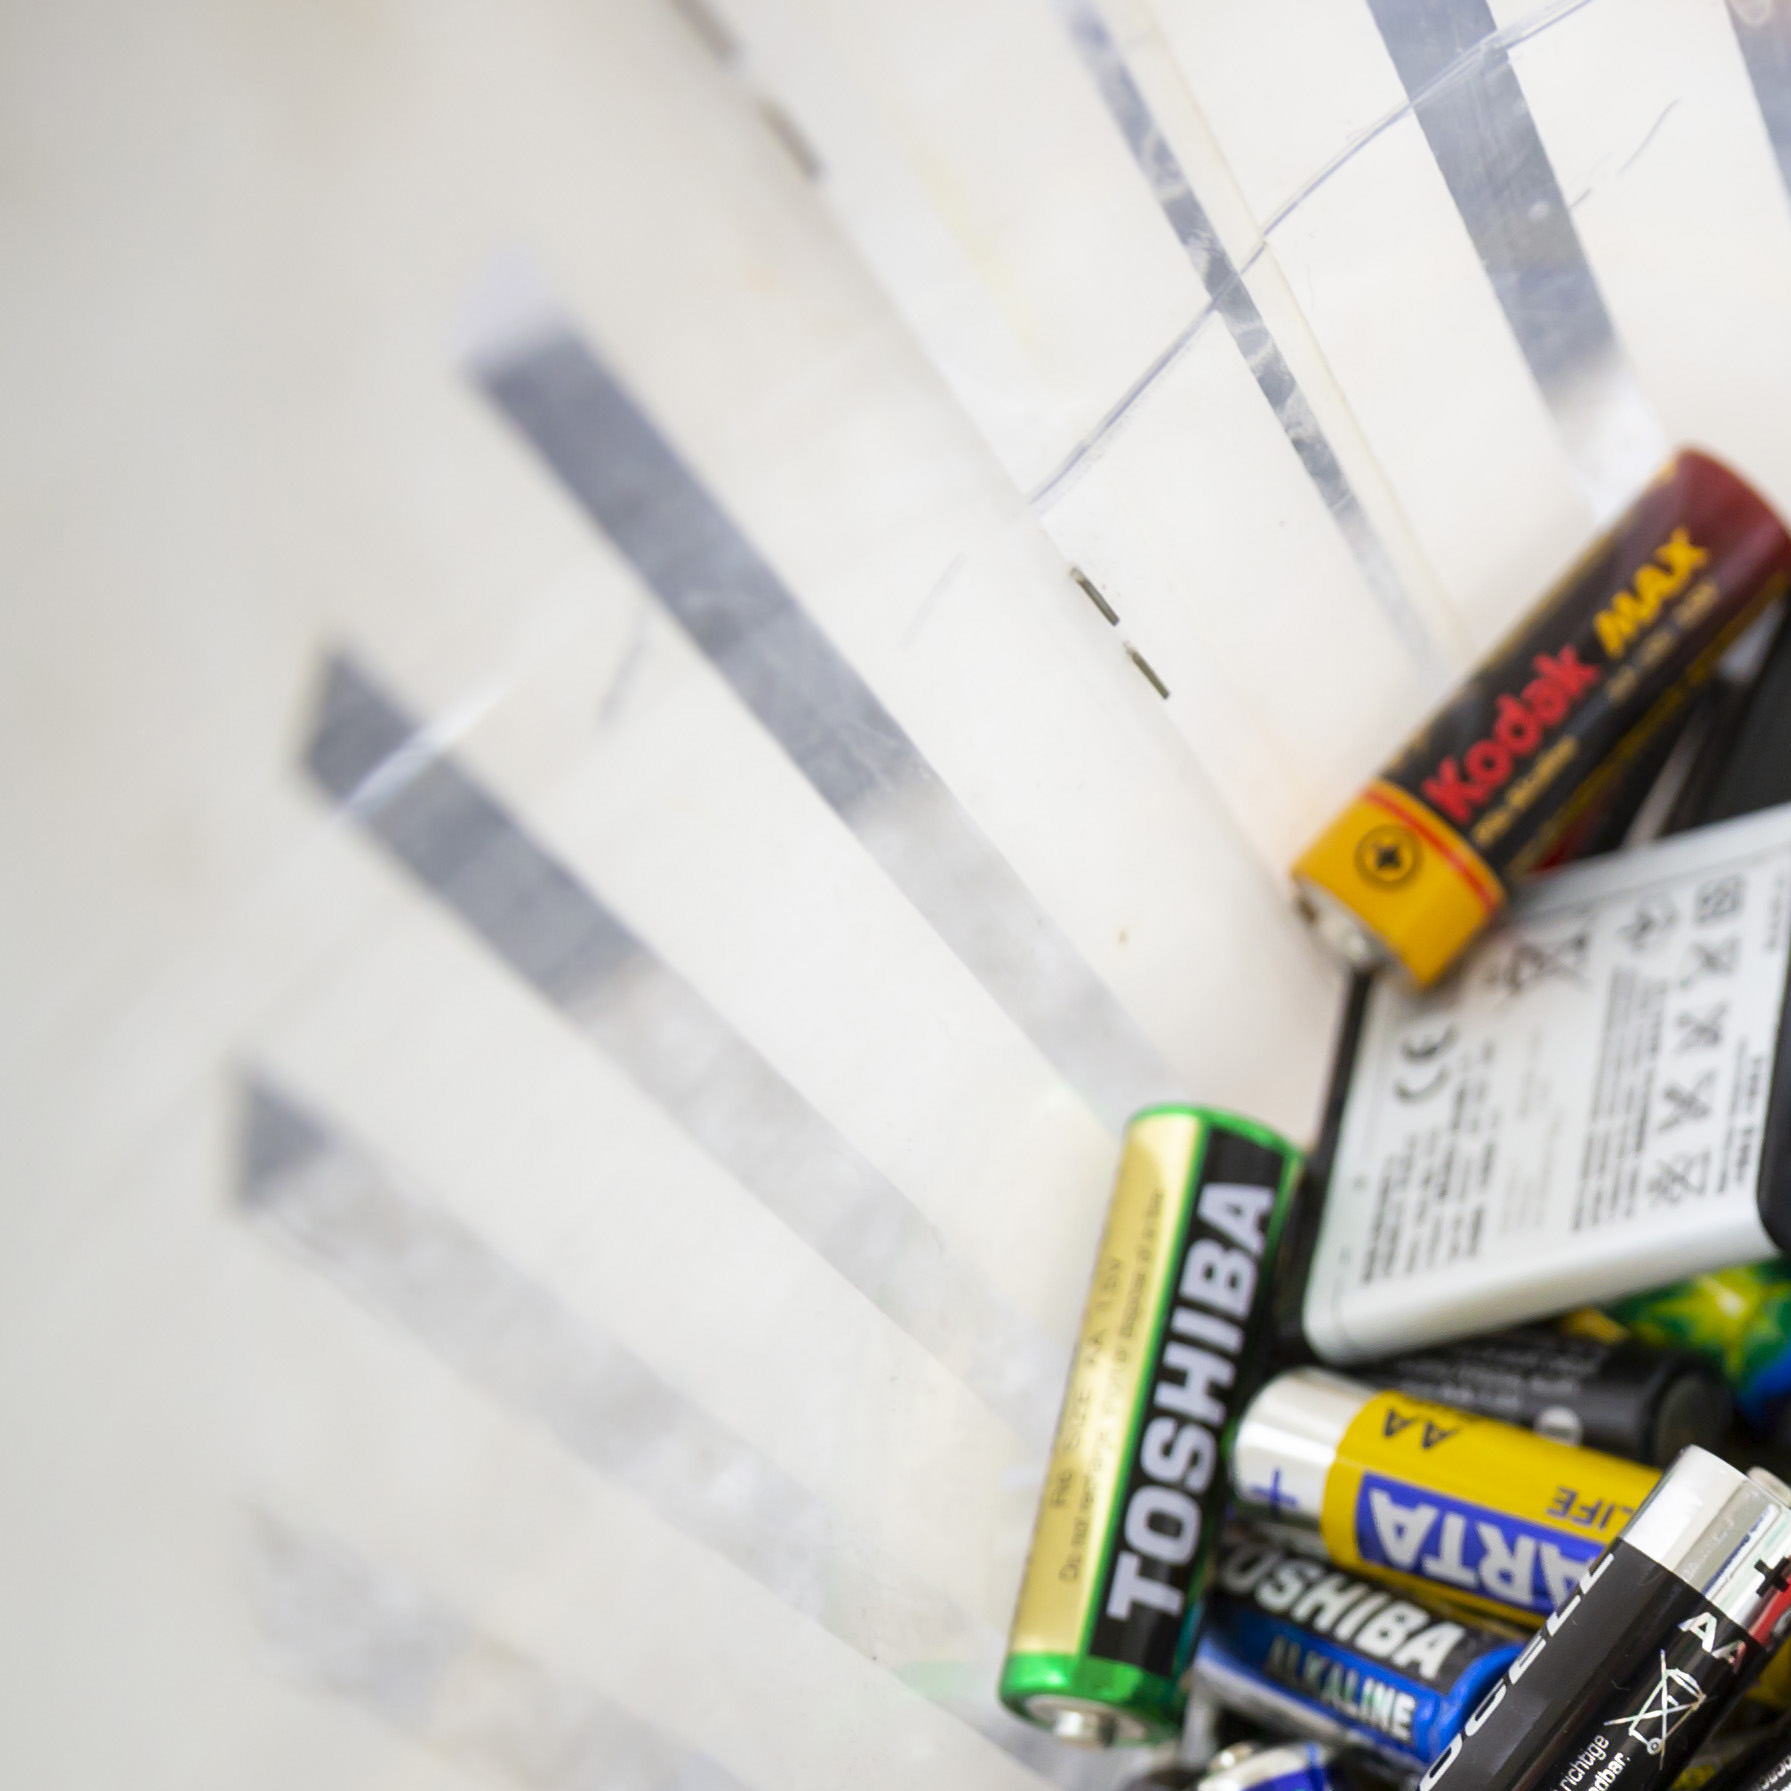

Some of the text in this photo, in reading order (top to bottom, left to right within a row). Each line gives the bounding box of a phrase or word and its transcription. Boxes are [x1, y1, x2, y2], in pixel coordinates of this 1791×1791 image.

[1421, 643, 1600, 824] Kodak
[1592, 526, 1708, 660] MAX
[1106, 1181, 1275, 1622] TOSHIBA
[1381, 1406, 1459, 1450] AA
[1219, 1541, 1464, 1678] OSHIBA
[1369, 1487, 1596, 1610] ARTA
[1266, 1637, 1416, 1737] ALKALINE
[1679, 1610, 1750, 1673] AA
